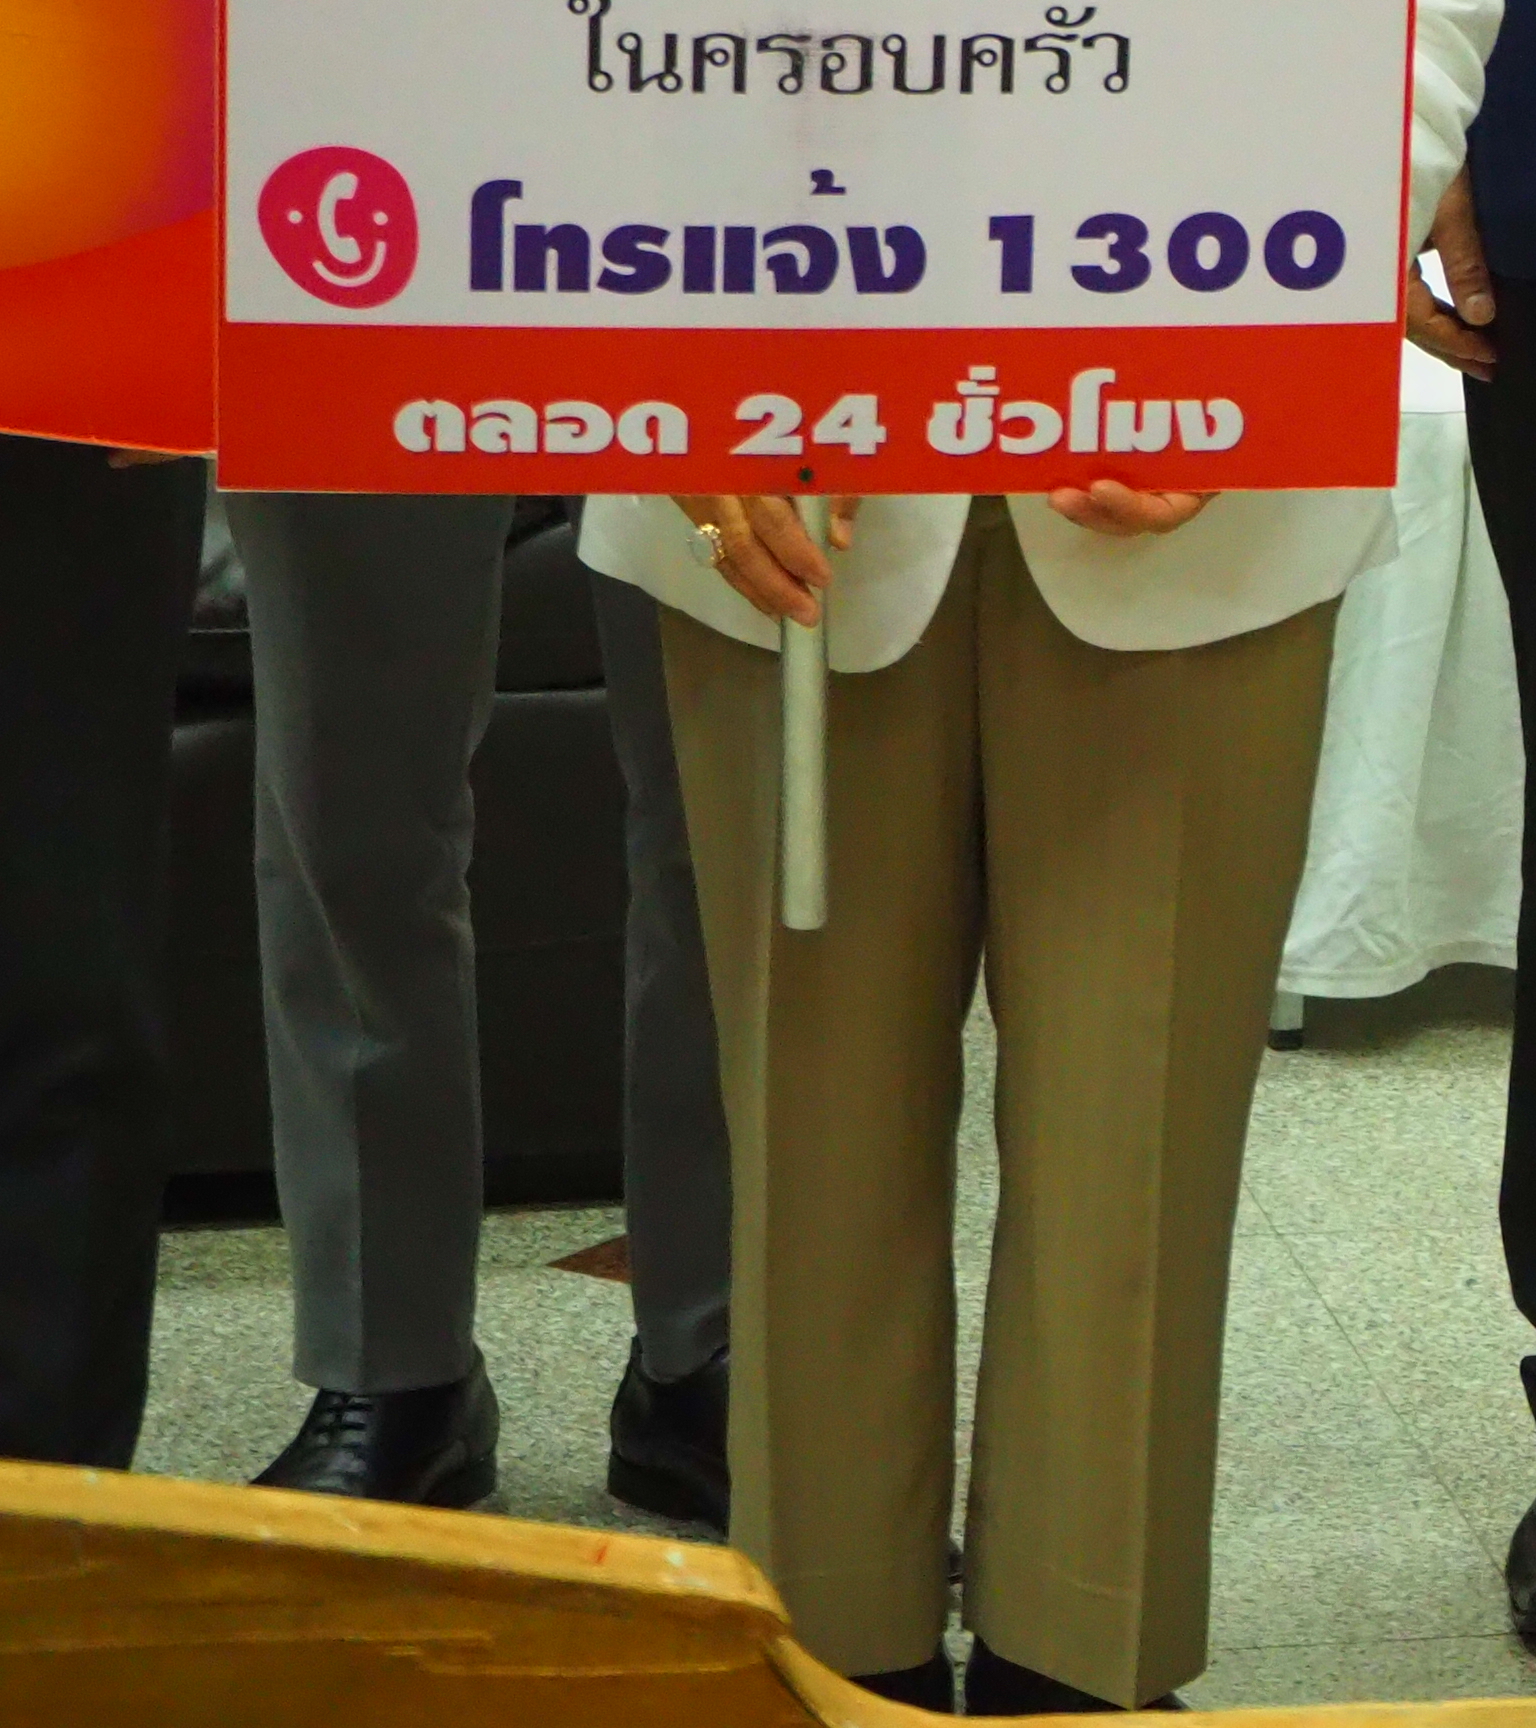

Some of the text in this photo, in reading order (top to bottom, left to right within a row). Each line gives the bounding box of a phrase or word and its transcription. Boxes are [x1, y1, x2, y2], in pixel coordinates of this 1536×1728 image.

[469, 169, 1347, 296] โทรแจ้ง 1300
[393, 365, 1245, 457] ตลอด 24 ชั่วโมง
